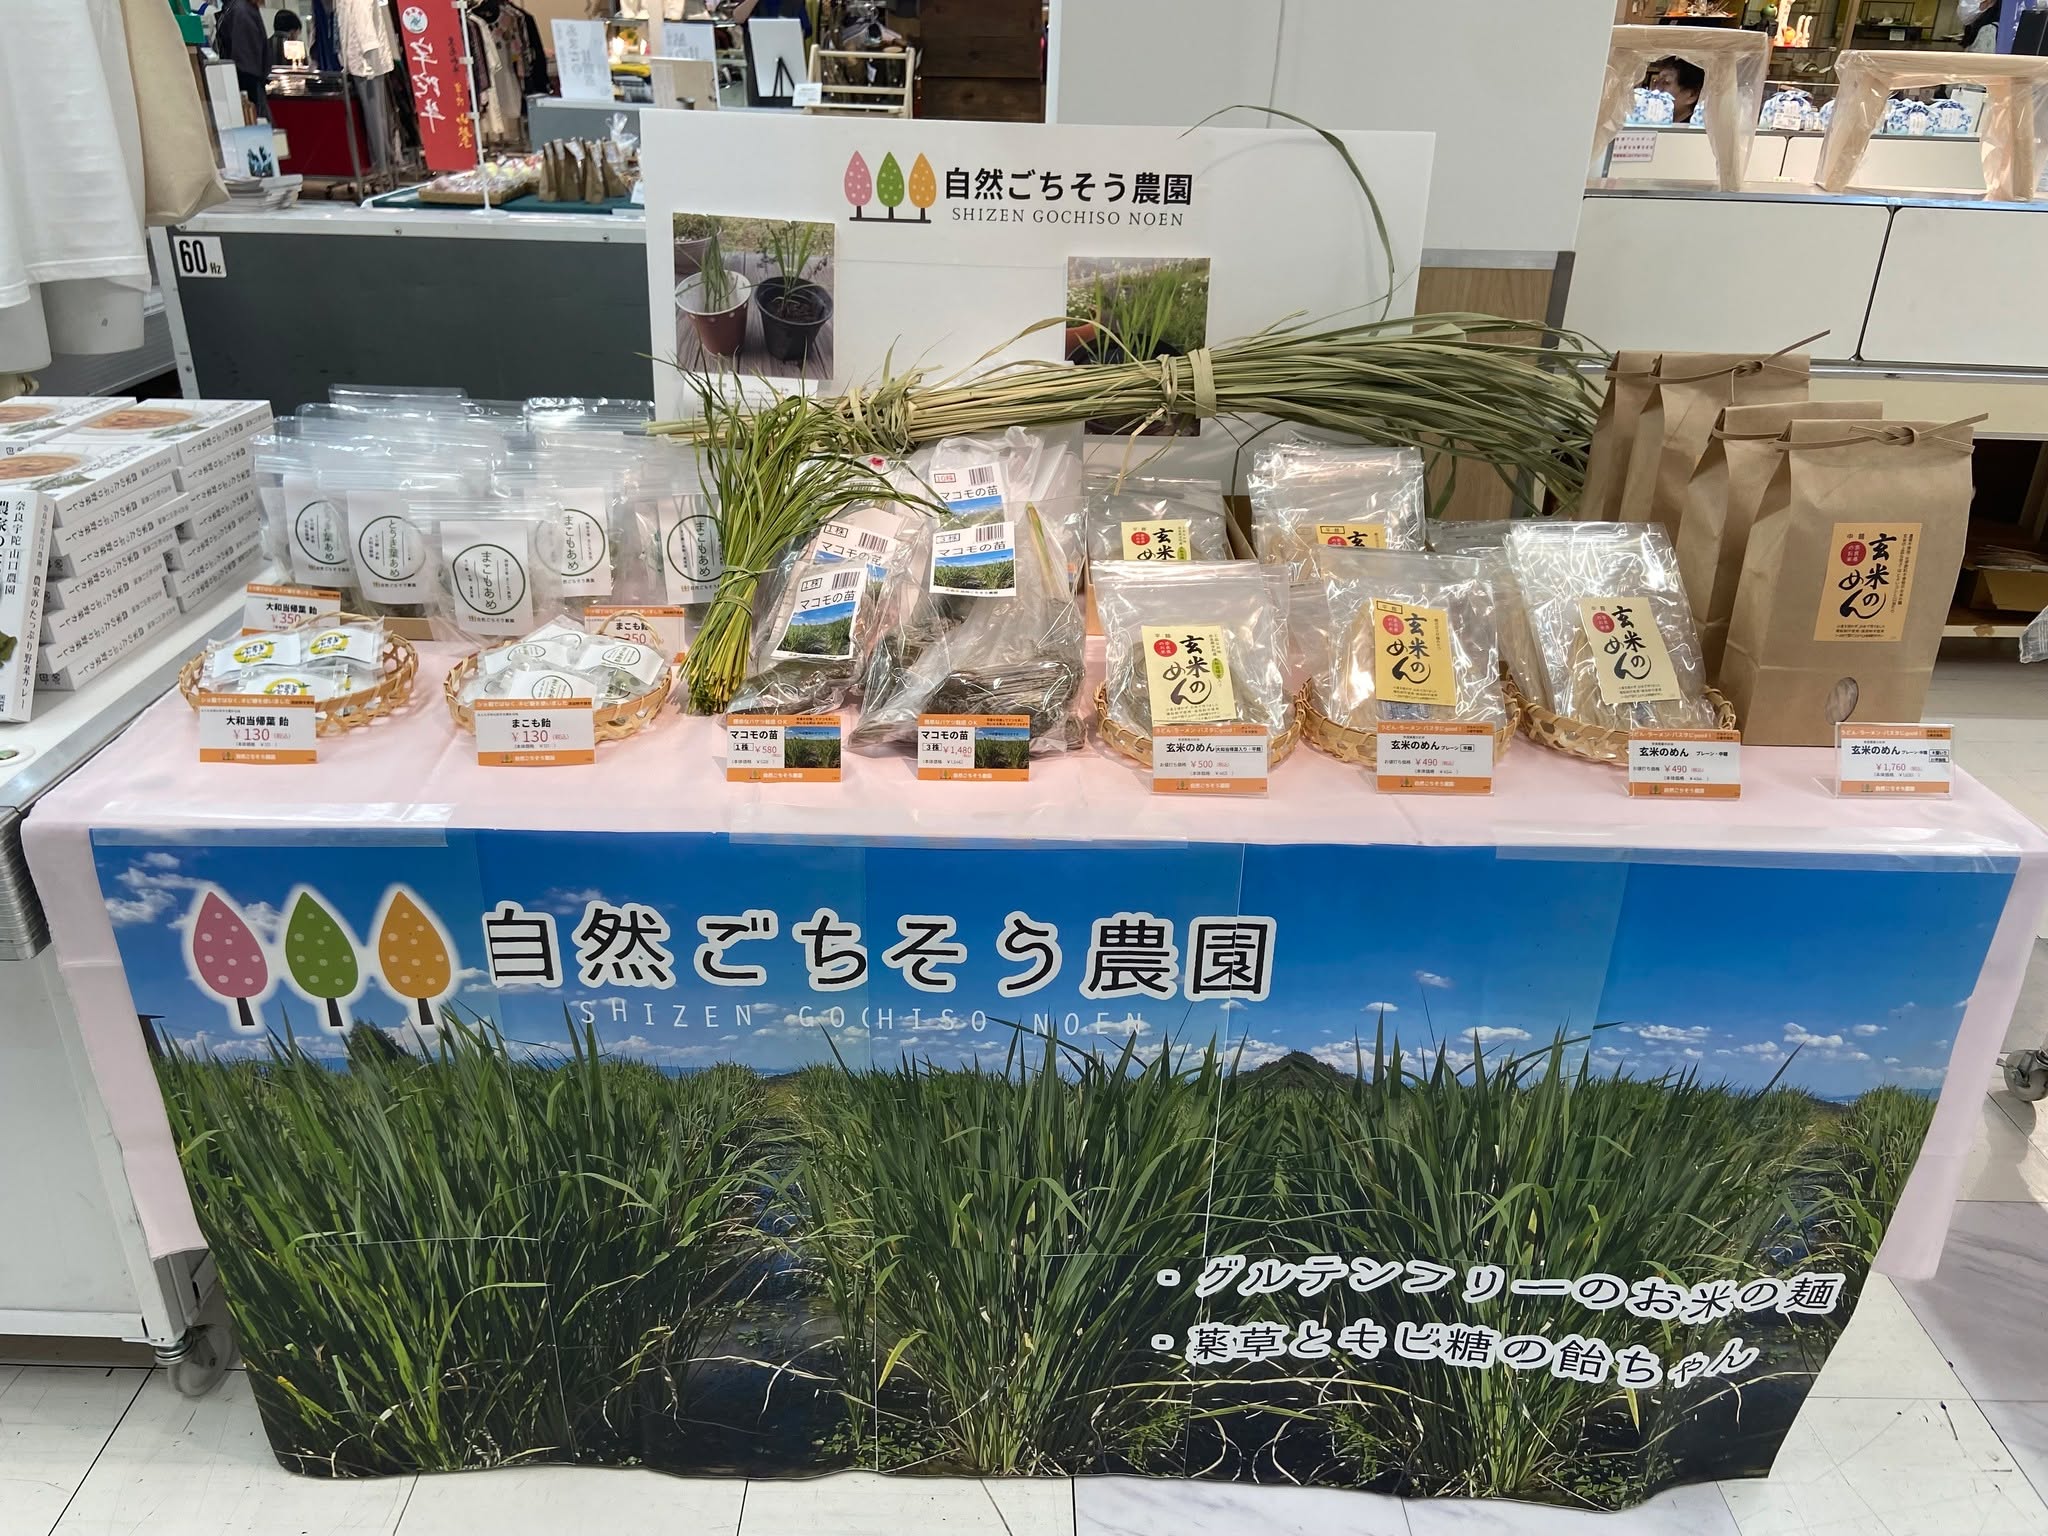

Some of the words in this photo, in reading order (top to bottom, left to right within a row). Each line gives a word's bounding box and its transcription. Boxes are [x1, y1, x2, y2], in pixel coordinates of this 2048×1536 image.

[945, 166, 1193, 206] 自然ごちそう農園
[952, 207, 1026, 223] SHIZEN
[1033, 209, 1121, 225] GOCHISO
[1128, 211, 1184, 227] NOEN
[179, 240, 207, 274] 60
[210, 262, 222, 274] Hz
[940, 485, 998, 501] マコモの苗
[5, 500, 26, 595] 奈良宇陀山口農園
[389, 519, 400, 577] とうき葉あめ
[564, 515, 579, 571] まこもあめ
[696, 521, 711, 577] まこもあめ
[938, 541, 1006, 556] マコモの苗
[481, 551, 497, 610] まこもあめ
[800, 590, 856, 610] マコモの苗
[266, 603, 306, 613] 大和当帰葉
[309, 607, 317, 615] 飴
[21, 574, 41, 709] 農家のたっぷり野菜カレー
[226, 715, 276, 726] 大和当帰葉
[279, 717, 289, 727] 飴
[511, 717, 552, 728] まこも飴
[233, 728, 270, 741] ¥130
[511, 730, 549, 743] ¥130
[730, 730, 778, 740] マコモの苗
[921, 730, 969, 740] マコモの苗
[735, 743, 749, 751] 1株
[755, 745, 777, 754] ¥580
[926, 743, 940, 751] 3株
[943, 746, 972, 755] ¥1,480
[1166, 743, 1215, 753] 玄米のめん
[1391, 740, 1440, 751] 玄米のめん
[1639, 747, 1689, 757] 玄米のめん
[1851, 745, 1901, 755] 玄米のめん
[1190, 760, 1213, 768] ¥500
[1415, 758, 1438, 766] ¥490
[1876, 763, 1906, 772] ¥1,760
[1664, 765, 1687, 773] ¥490
[484, 904, 1273, 999] 自然ごちそう農園
[580, 1000, 753, 1029] SHIZEN
[797, 1005, 988, 1034] GOCHISO
[1032, 1011, 1143, 1037] NOEN
